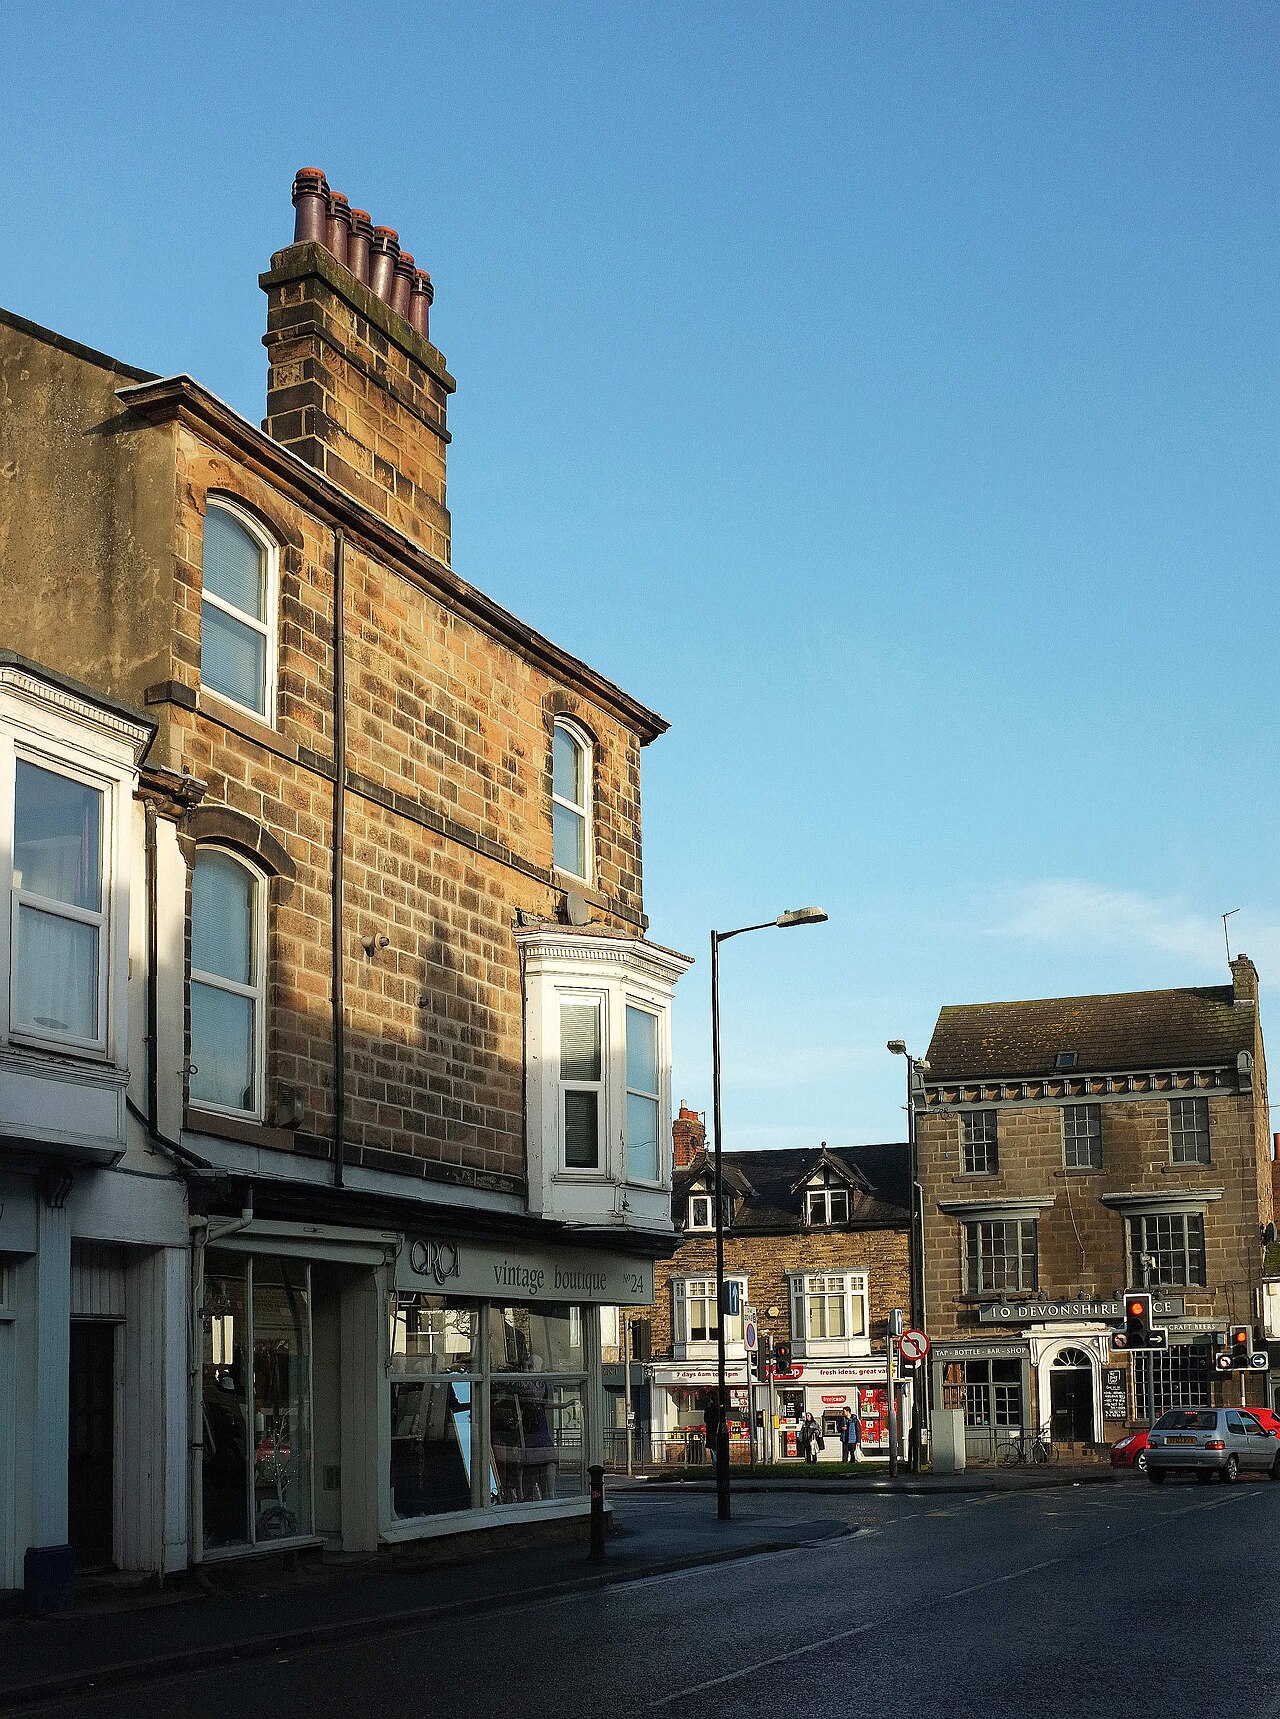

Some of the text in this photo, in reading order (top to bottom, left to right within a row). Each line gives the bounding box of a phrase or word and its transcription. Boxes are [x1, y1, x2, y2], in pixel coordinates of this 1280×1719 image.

[493, 1259, 544, 1295] vintage
[554, 1265, 607, 1297] boutique
[631, 1274, 644, 1293] 24
[1018, 1303, 1119, 1317] DEVONSHIRE
[1168, 1323, 1192, 1331] CRAFT
[1194, 1322, 1216, 1330] BEERS
[682, 1371, 696, 1379] days
